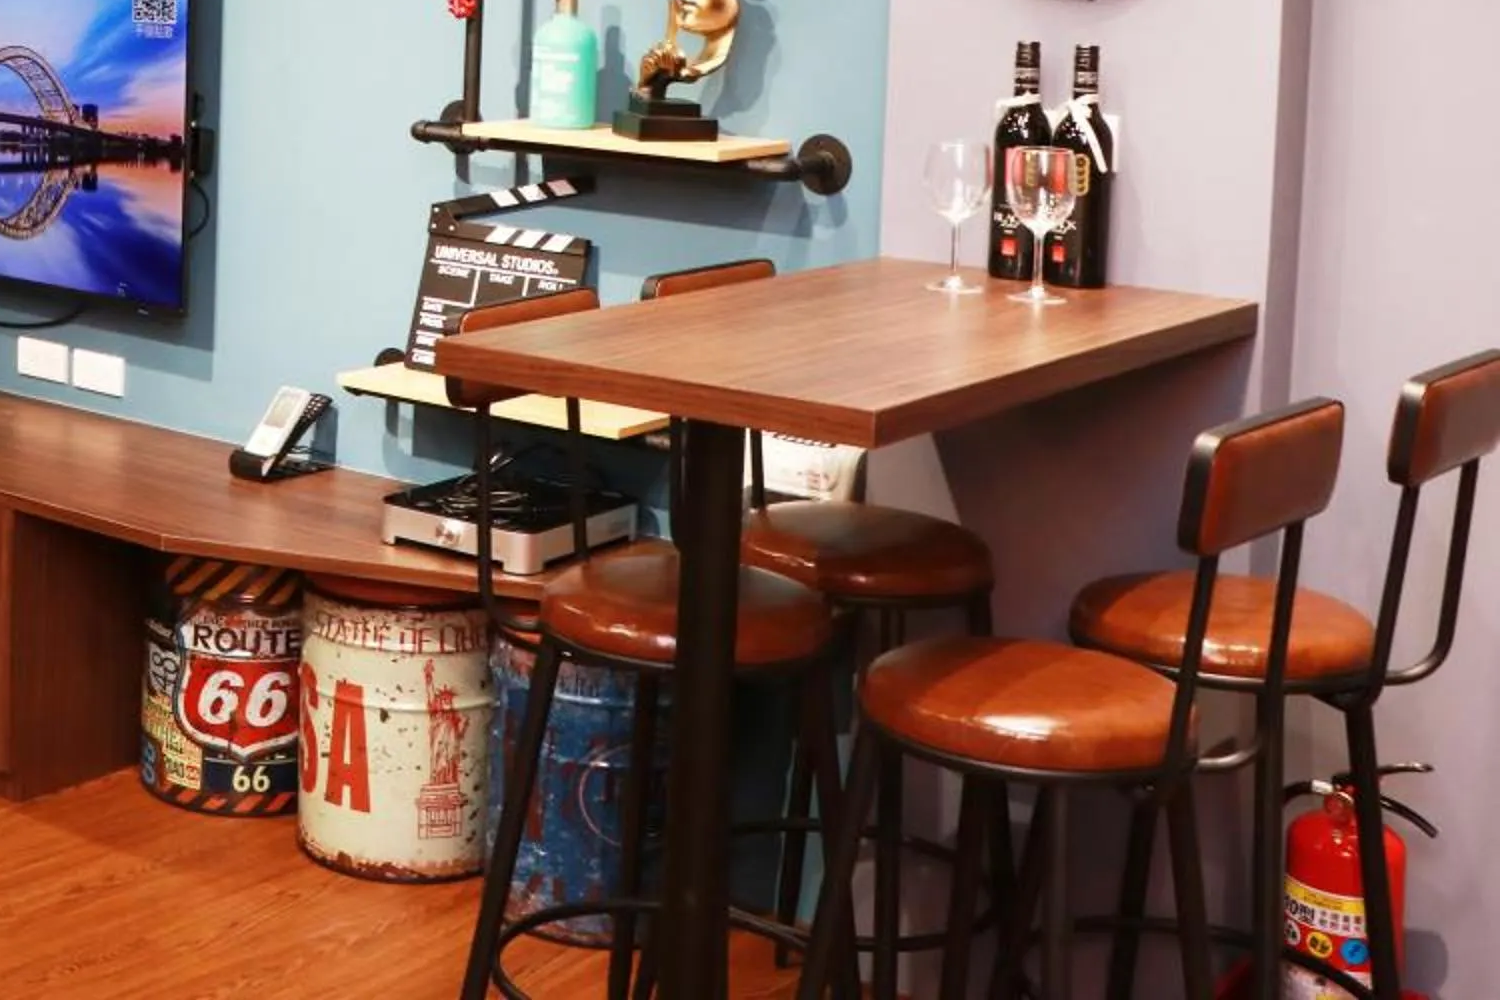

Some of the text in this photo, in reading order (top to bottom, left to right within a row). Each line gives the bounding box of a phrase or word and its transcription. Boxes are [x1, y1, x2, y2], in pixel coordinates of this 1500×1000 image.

[435, 245, 556, 274] UNIVERSAL STUDIOS
[192, 623, 302, 656] ROUTE
[197, 670, 292, 728] 66
[231, 765, 272, 793] 66
